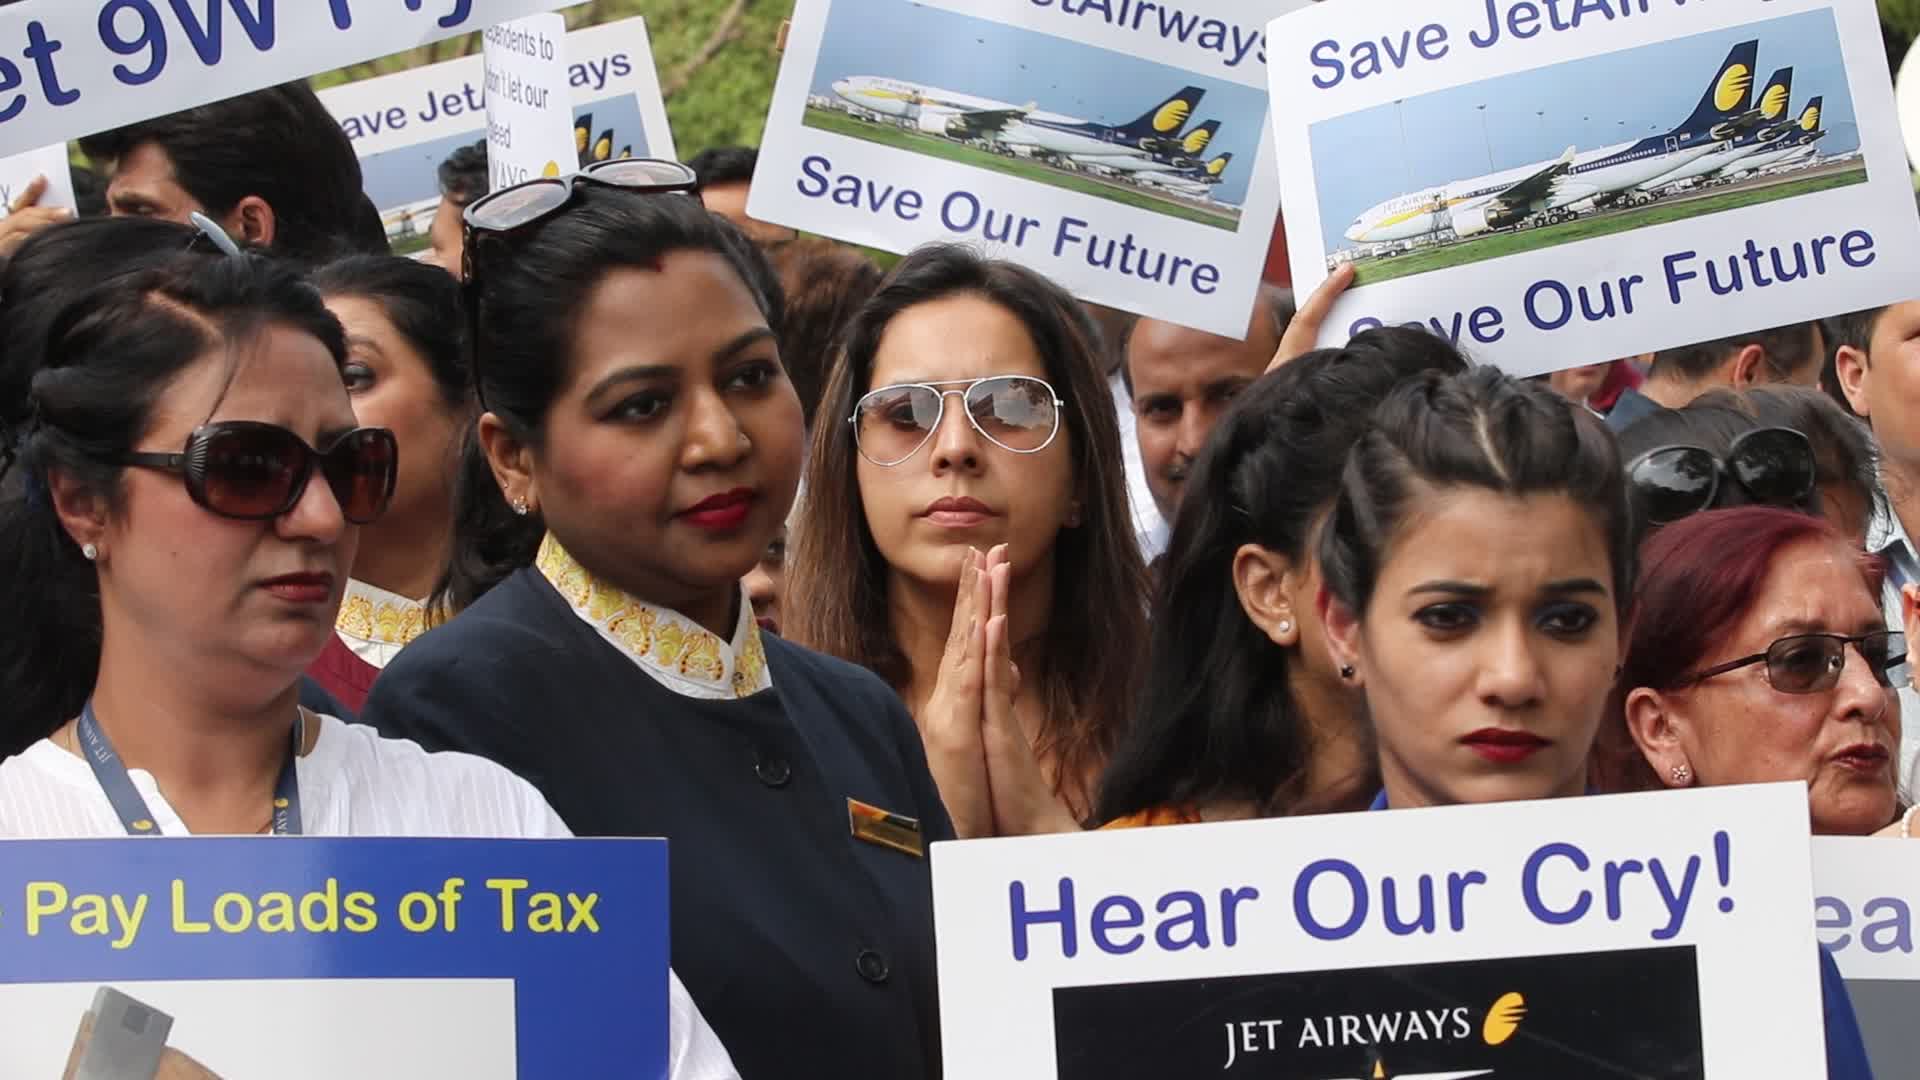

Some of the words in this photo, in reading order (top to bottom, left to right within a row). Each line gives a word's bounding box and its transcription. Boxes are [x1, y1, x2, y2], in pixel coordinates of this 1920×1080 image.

[539, 31, 555, 61] to
[1309, 22, 1449, 90] Save
[342, 106, 408, 141] ave
[568, 53, 631, 90] ays
[525, 84, 549, 110] our
[797, 155, 924, 221] Save
[941, 190, 1041, 248] Our
[1053, 216, 1221, 295] Future
[1524, 275, 1643, 332] Our
[1662, 229, 1877, 305] Future
[25, 881, 149, 949] Pay
[171, 879, 378, 934] Loads
[398, 877, 465, 933] of
[486, 879, 600, 933] Tax
[1008, 877, 1259, 962] Hear
[1292, 857, 1487, 943] Our
[1520, 830, 1735, 942] Cry!
[1814, 895, 1914, 954] ea
[1224, 1019, 1283, 1070] JET
[1298, 1006, 1472, 1049] AIRWAYS
